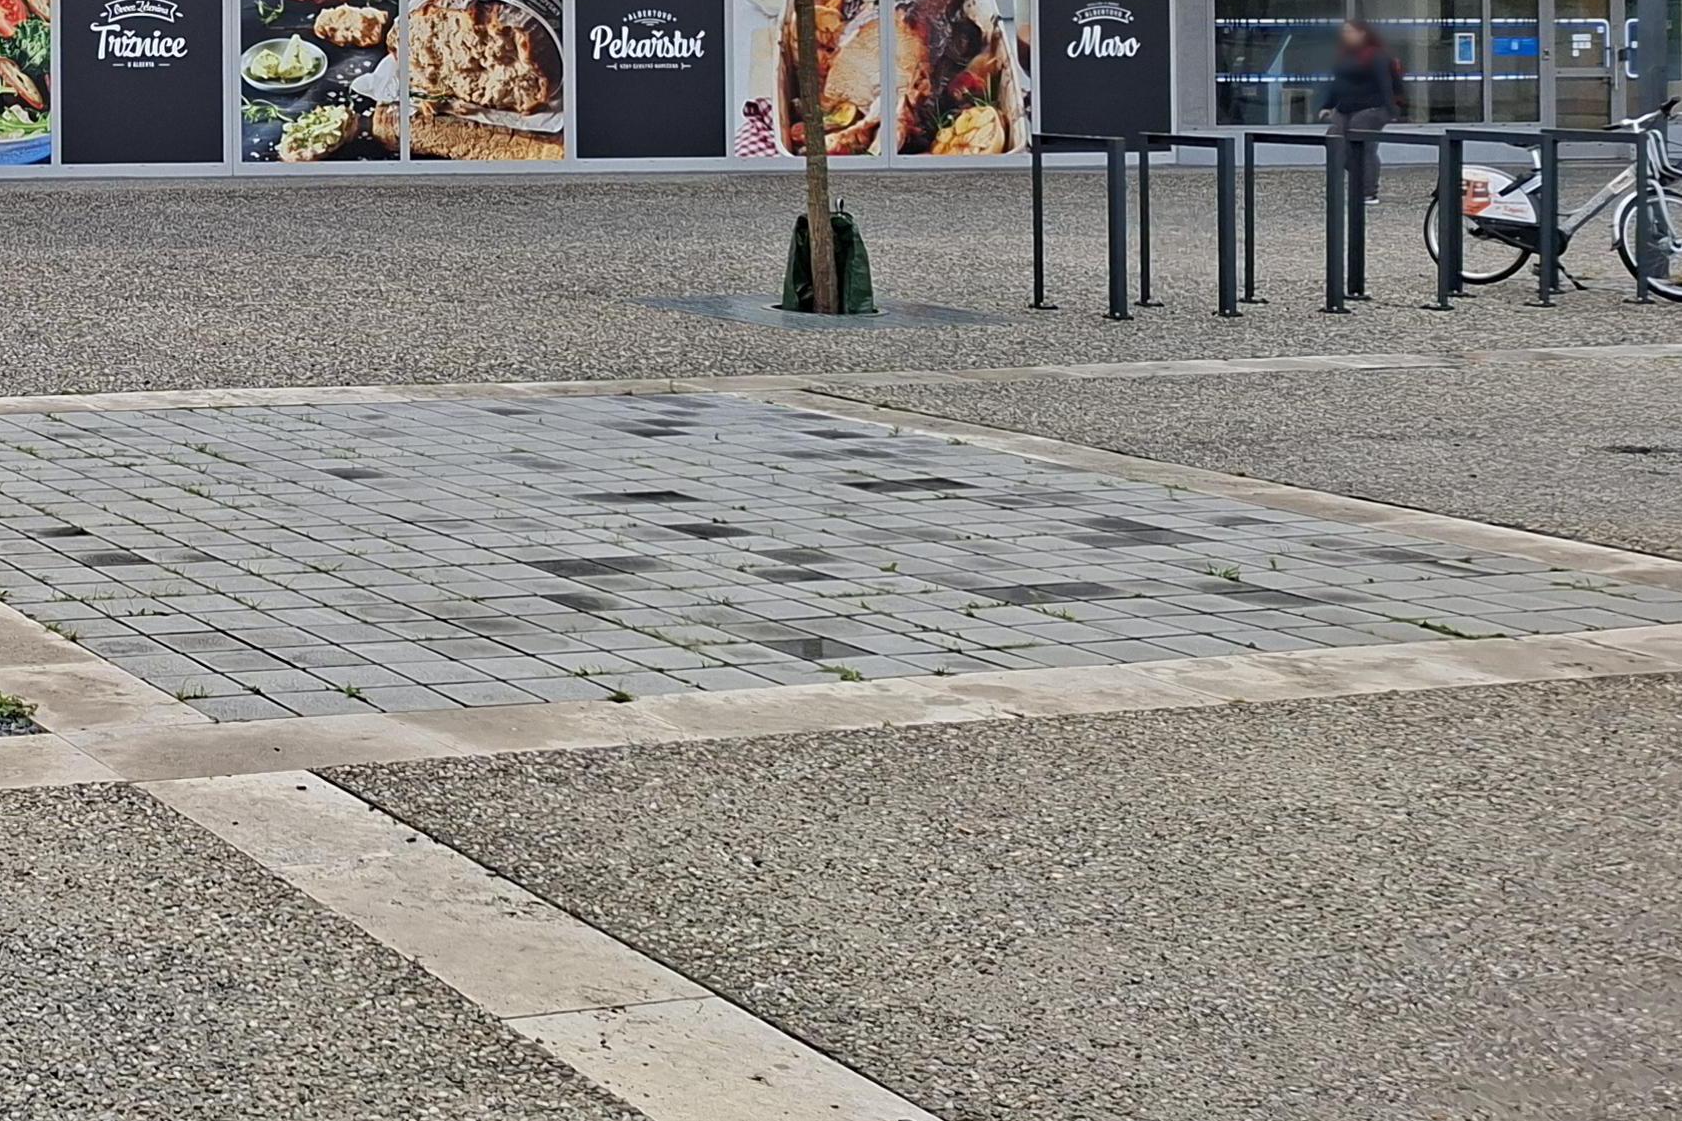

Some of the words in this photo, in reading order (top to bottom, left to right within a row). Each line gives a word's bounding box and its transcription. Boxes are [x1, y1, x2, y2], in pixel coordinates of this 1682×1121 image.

[627, 9, 672, 21] ALBERTOVO
[90, 22, 188, 60] Tržnice
[589, 25, 706, 60] Pekařství
[1067, 25, 1141, 58] Maso
